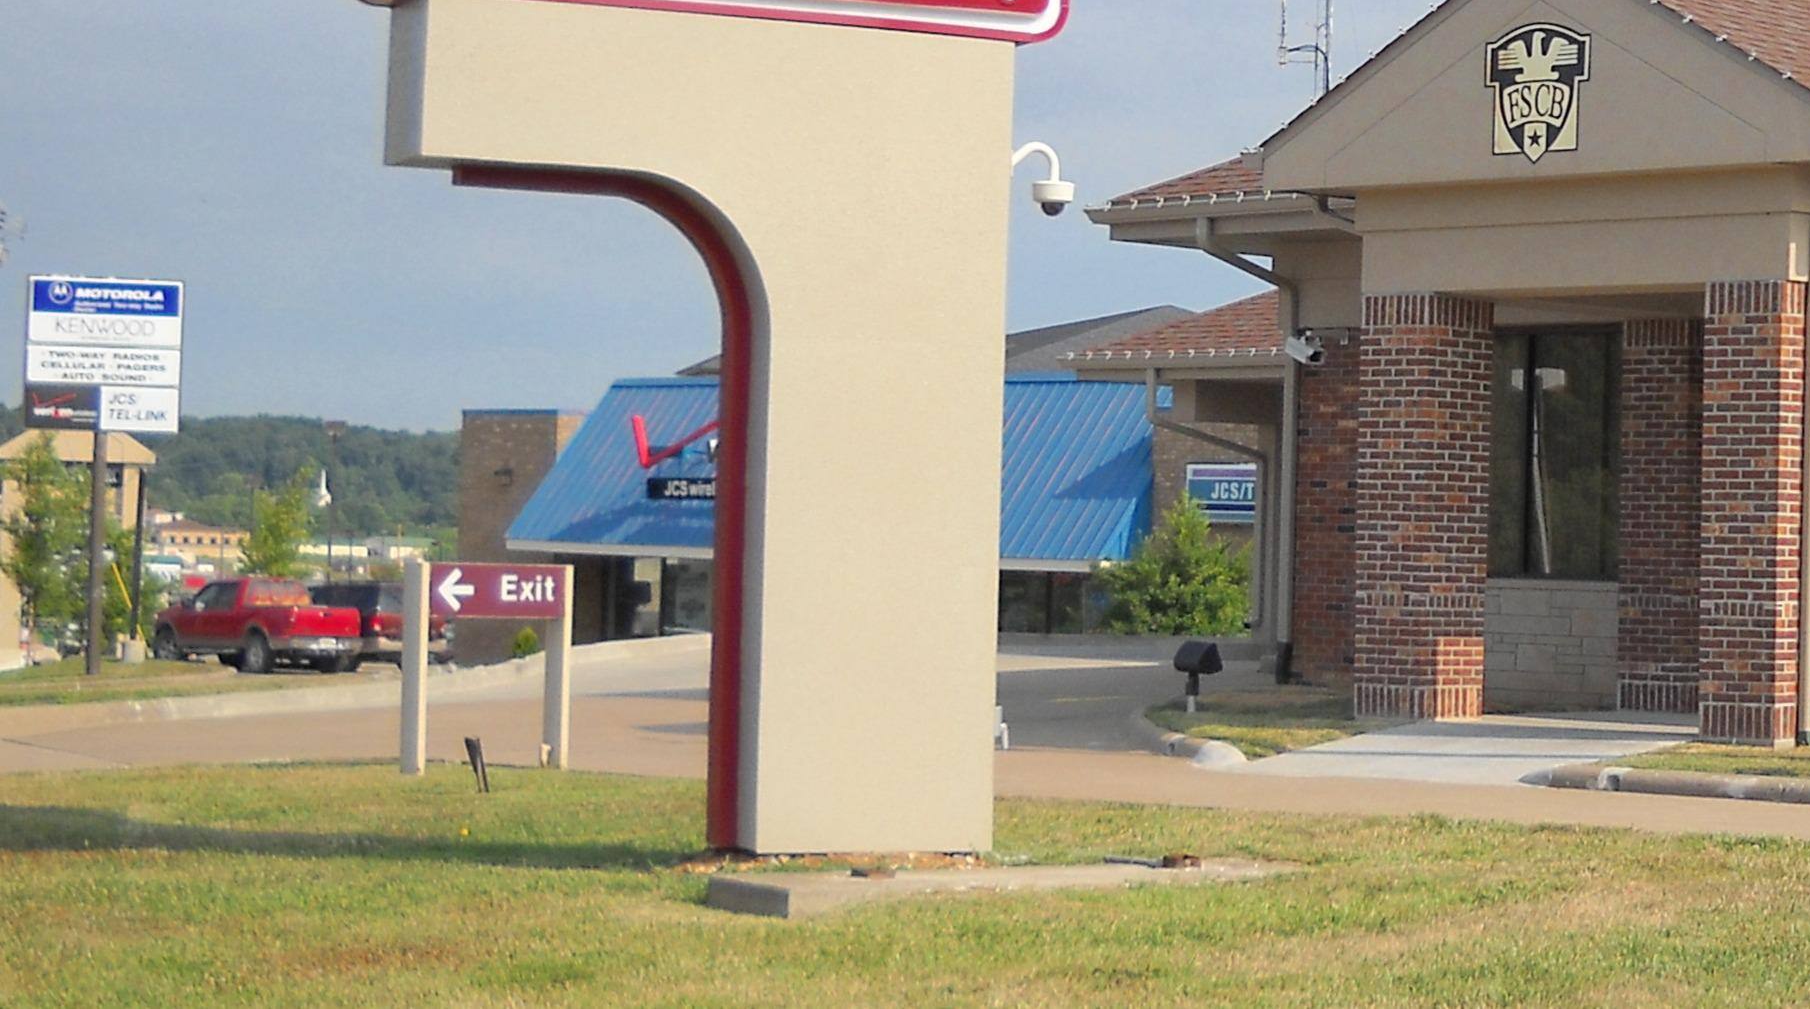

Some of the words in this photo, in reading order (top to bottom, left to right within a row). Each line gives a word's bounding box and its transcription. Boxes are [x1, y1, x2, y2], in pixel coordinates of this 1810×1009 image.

[1506, 83, 1565, 124] FSCB
[74, 287, 165, 302] MOTOROLA
[55, 317, 156, 336] KENWOOD
[108, 393, 137, 405] JCS
[108, 408, 168, 422] TEL-LINK
[663, 480, 688, 496] JCS
[1210, 482, 1255, 501] JCS/T
[501, 574, 555, 602] Exit
